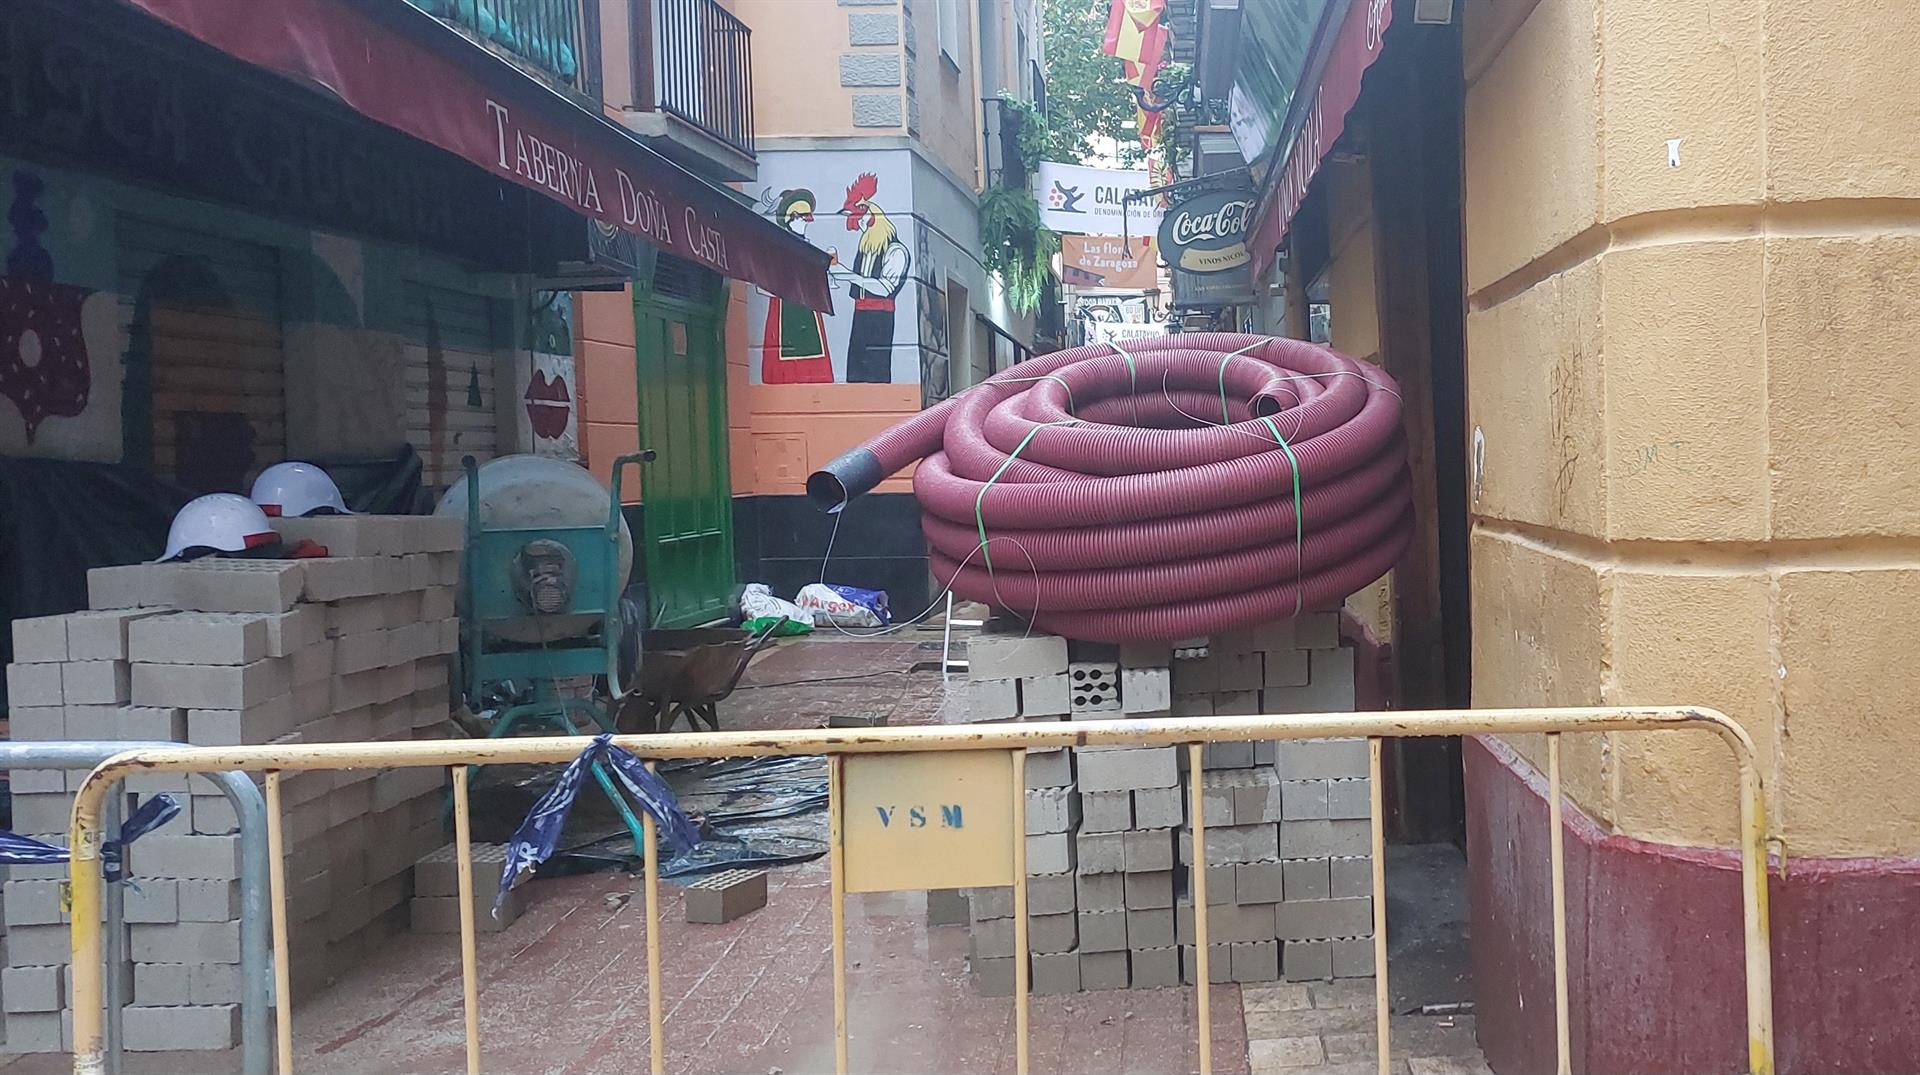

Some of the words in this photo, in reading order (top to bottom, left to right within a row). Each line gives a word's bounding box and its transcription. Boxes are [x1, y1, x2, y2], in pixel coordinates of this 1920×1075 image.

[485, 98, 604, 213] TABERNA
[615, 168, 673, 245] DOÑA
[684, 206, 729, 271] CASTA
[1095, 185, 1155, 208] CALATAY
[1094, 207, 1141, 218] DENOMINCIÓN
[1172, 198, 1257, 245] Coca-Col
[1084, 241, 1100, 253] Las
[1104, 241, 1132, 255] flor
[1080, 255, 1091, 266] de
[1093, 255, 1138, 272] Zaragoza
[1199, 256, 1222, 265] VINOS
[1223, 250, 1244, 262] NICOL
